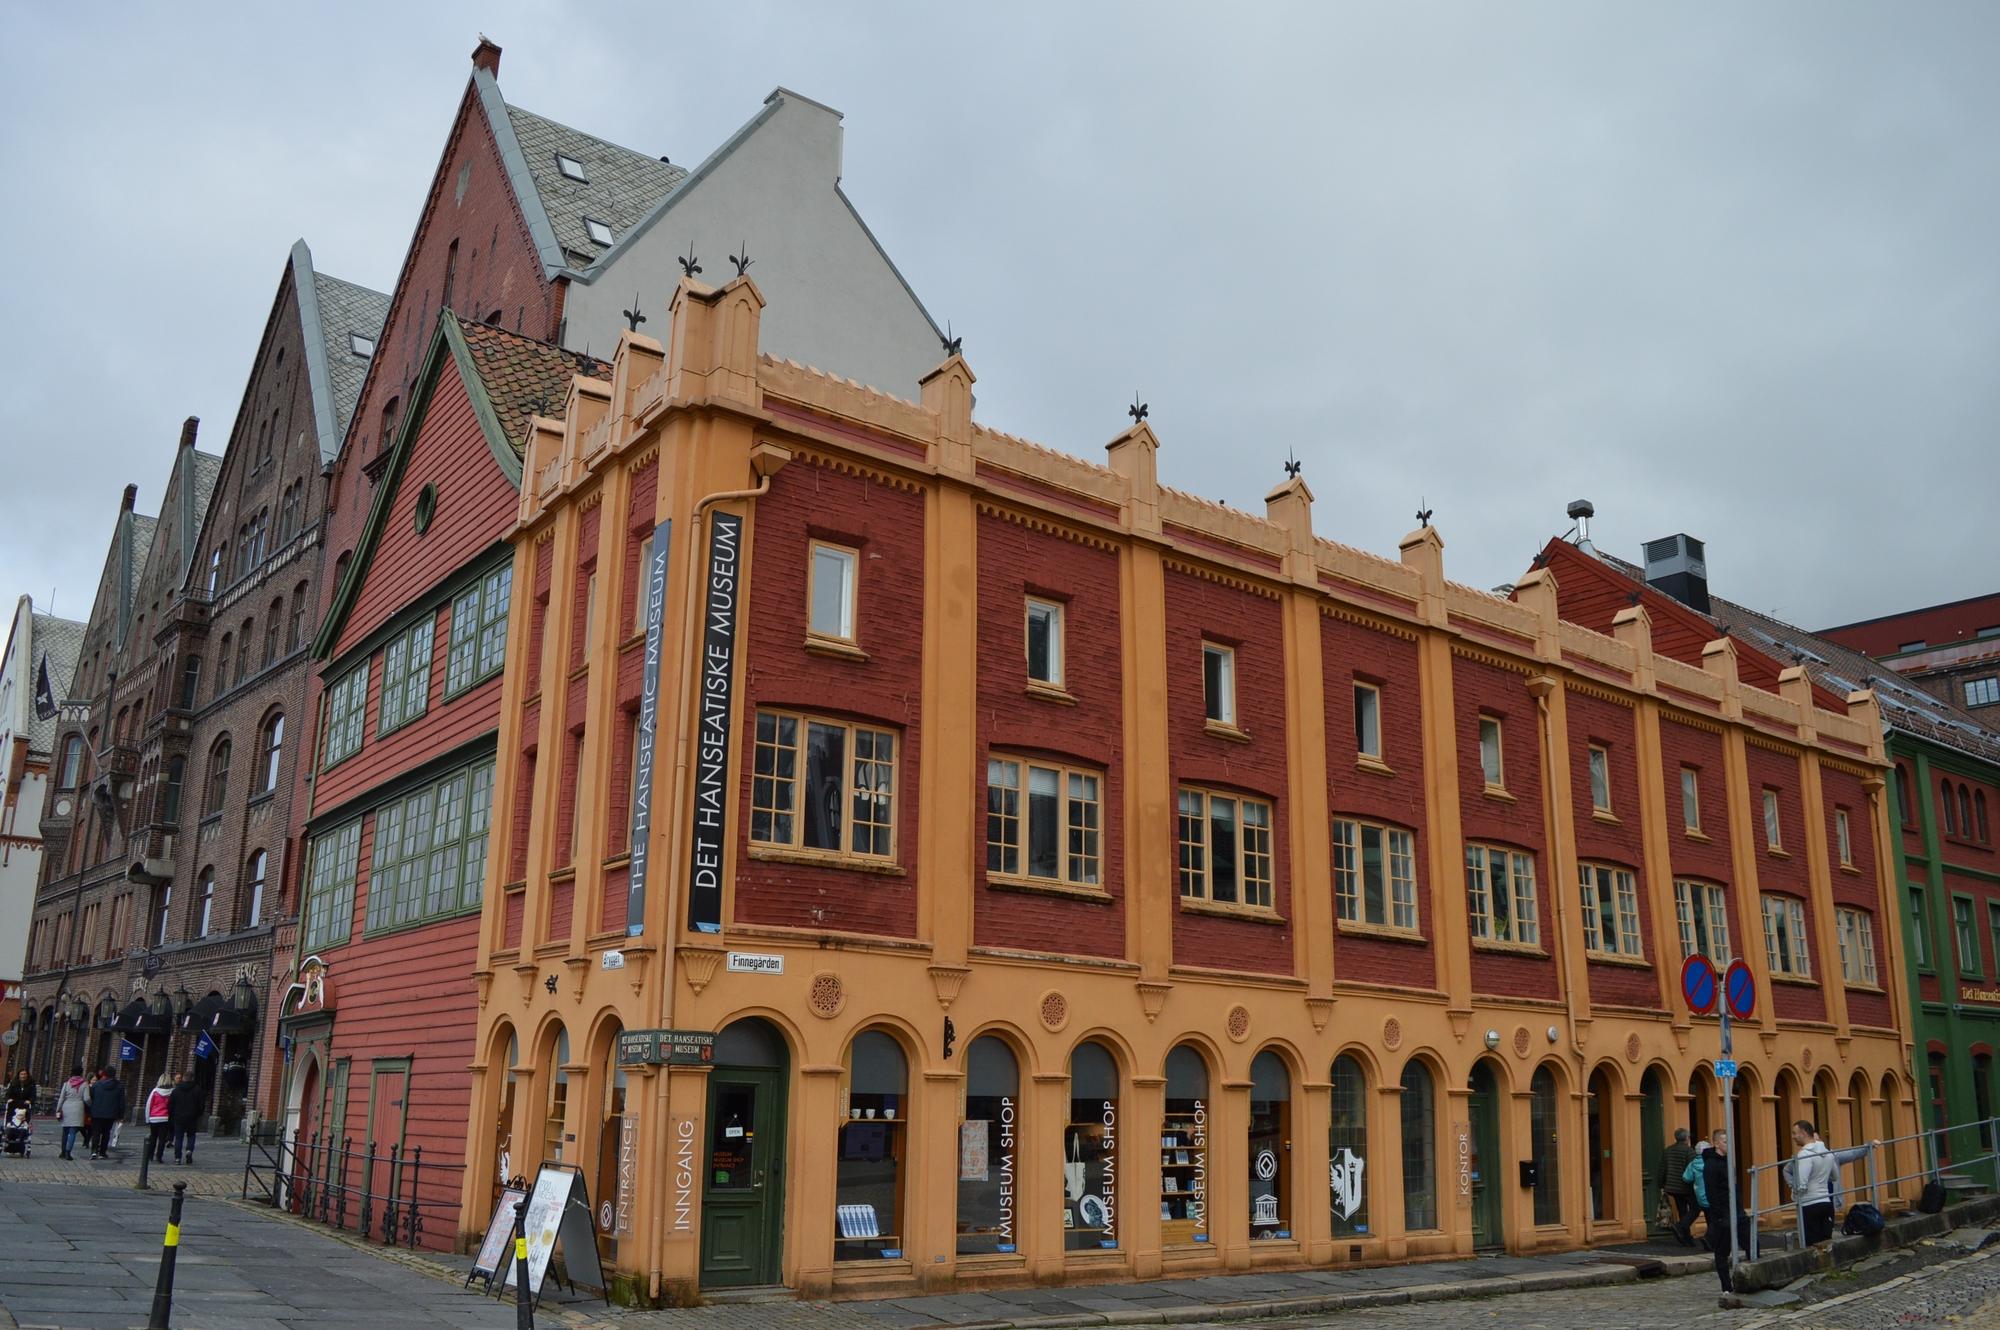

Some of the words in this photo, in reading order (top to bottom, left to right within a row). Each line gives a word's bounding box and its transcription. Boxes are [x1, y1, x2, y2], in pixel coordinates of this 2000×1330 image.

[648, 550, 666, 665] MUSEUM
[709, 522, 737, 636] MUSEUM
[636, 677, 656, 831] HANSEATIC
[699, 644, 729, 827] HANSEATISKE
[632, 842, 645, 894] THE
[696, 838, 718, 889] DET
[732, 954, 780, 970] Finnegården
[660, 1034, 673, 1043] DET
[674, 1035, 714, 1045] HANSEATISKE
[675, 1044, 700, 1055] MUSEUM
[1001, 1097, 1014, 1148] SHOP
[1103, 1100, 1115, 1149] SHOP
[1194, 1100, 1205, 1146] SHOP
[619, 1119, 633, 1230] ENTRANCE
[674, 1120, 694, 1230] INNGANG
[1000, 1154, 1013, 1238] MUSEUM
[1103, 1155, 1115, 1235] MUSEUM
[1194, 1152, 1205, 1229] MUSEUM
[1459, 1134, 1469, 1195] KONTOR
